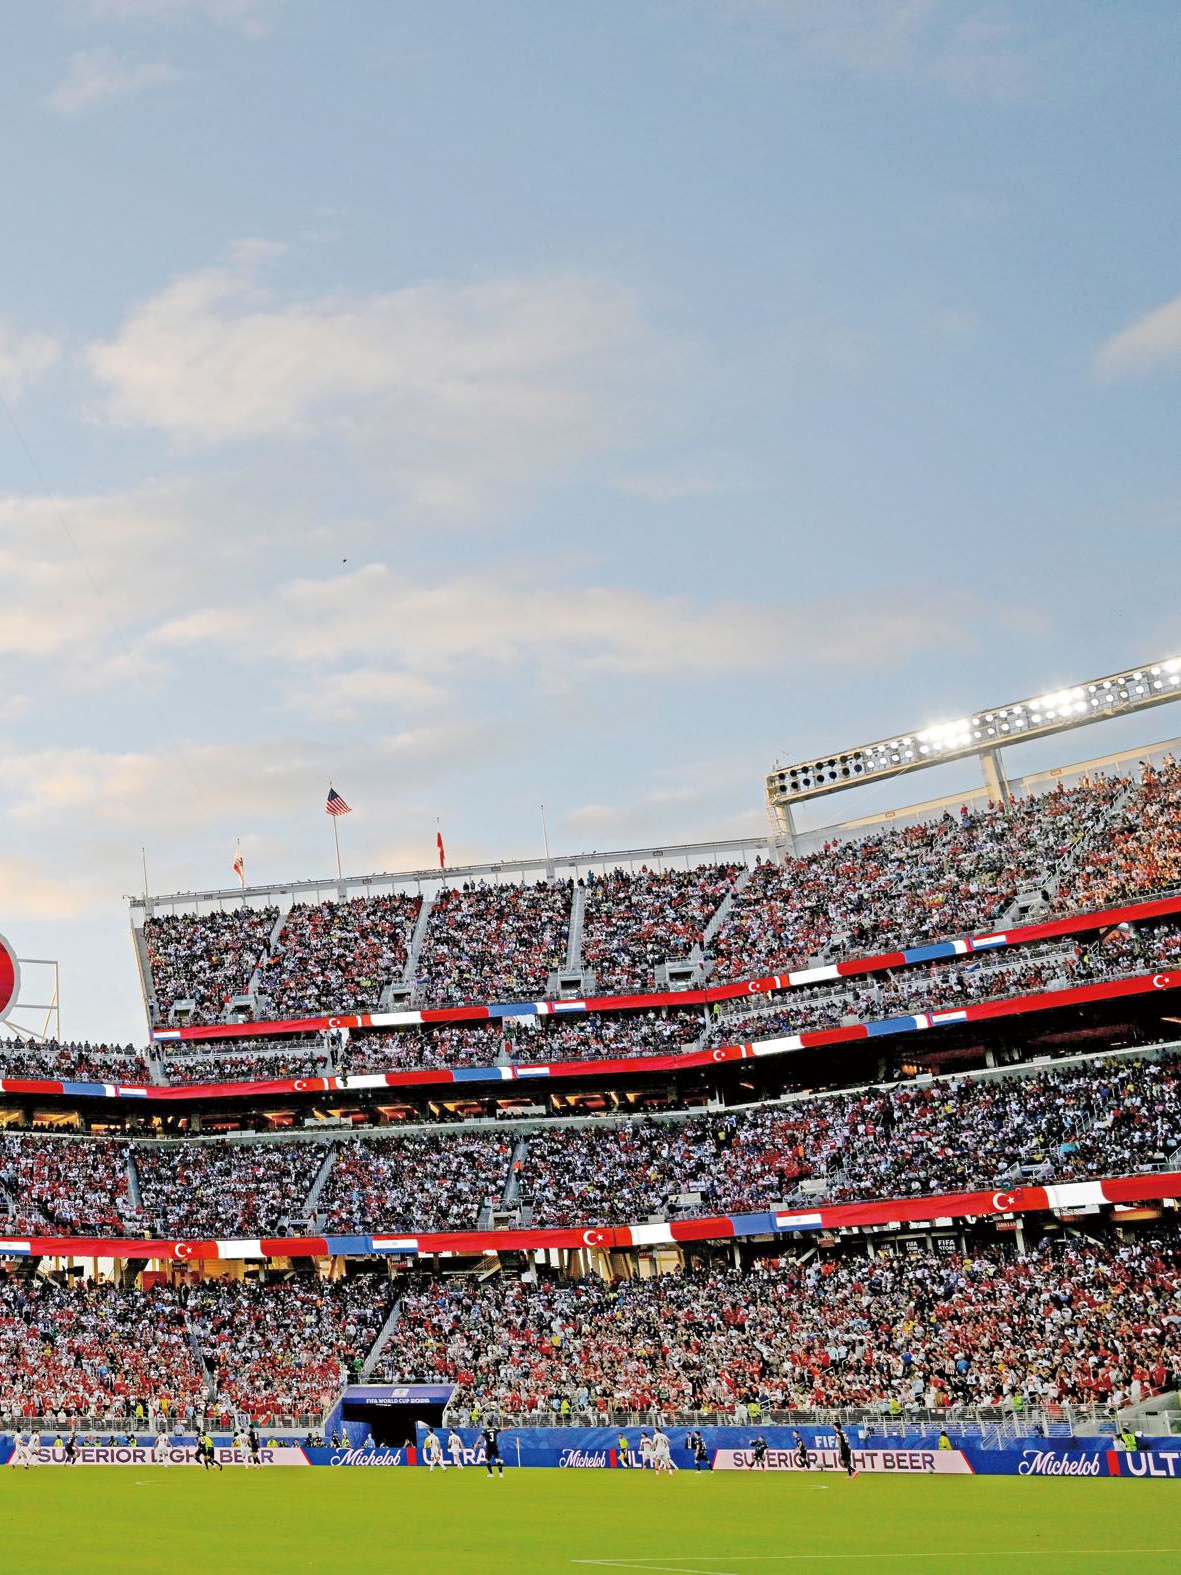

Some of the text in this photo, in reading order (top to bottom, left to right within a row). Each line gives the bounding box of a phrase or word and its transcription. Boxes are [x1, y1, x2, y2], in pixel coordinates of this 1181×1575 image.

[489, 1432, 495, 1442] 3
[38, 1449, 146, 1463] SUERIOR
[330, 1447, 401, 1466] Michelob
[559, 1449, 606, 1468] Michelob
[822, 1453, 878, 1468] LIHT
[884, 1452, 936, 1470] BEER
[1018, 1450, 1181, 1476] Michelob ULT
